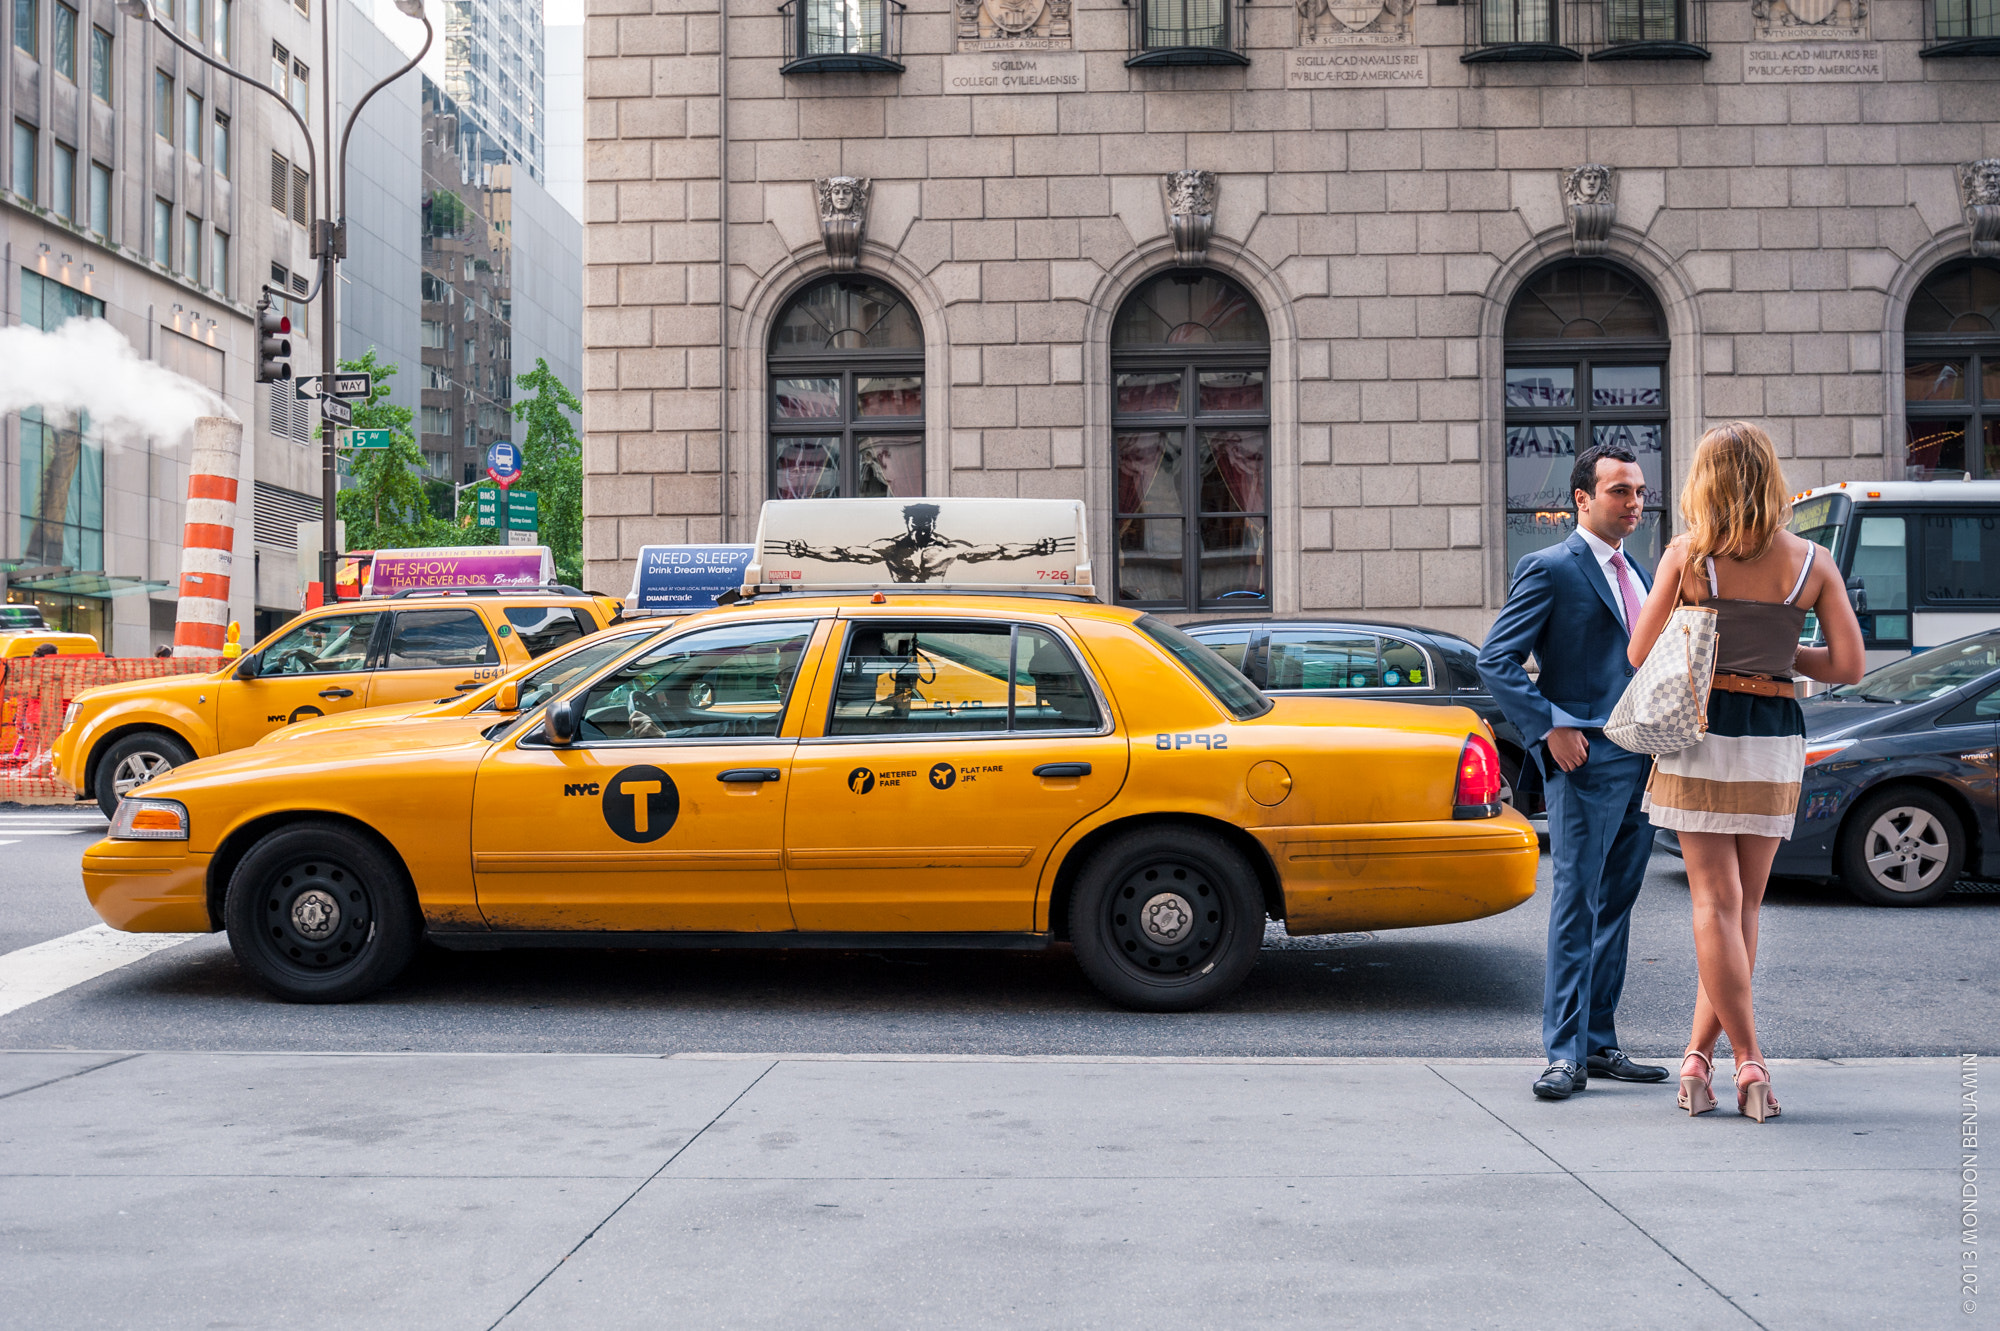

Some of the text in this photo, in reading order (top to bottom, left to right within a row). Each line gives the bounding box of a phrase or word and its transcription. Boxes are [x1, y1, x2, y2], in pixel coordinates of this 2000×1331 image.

[1323, 36, 1364, 44] SCIENTIA
[992, 62, 1037, 71] SIGILLVM
[340, 381, 362, 391] WAY
[356, 432, 380, 446] 5 AV
[480, 490, 496, 500] BM3
[480, 504, 496, 513] BM4
[480, 516, 496, 526] BM5
[650, 552, 748, 564] NEED SLEEP?
[378, 562, 458, 576] THE SHOW
[648, 566, 672, 574] Drink
[674, 566, 705, 574] Dream
[1037, 570, 1069, 580] 7-26
[390, 574, 488, 587] THAT NEVER ENDS.
[268, 714, 286, 722] NYC
[1156, 734, 1228, 750] 8P92
[880, 770, 917, 779] METERED
[564, 783, 600, 796] NYC
[620, 780, 662, 832] T
